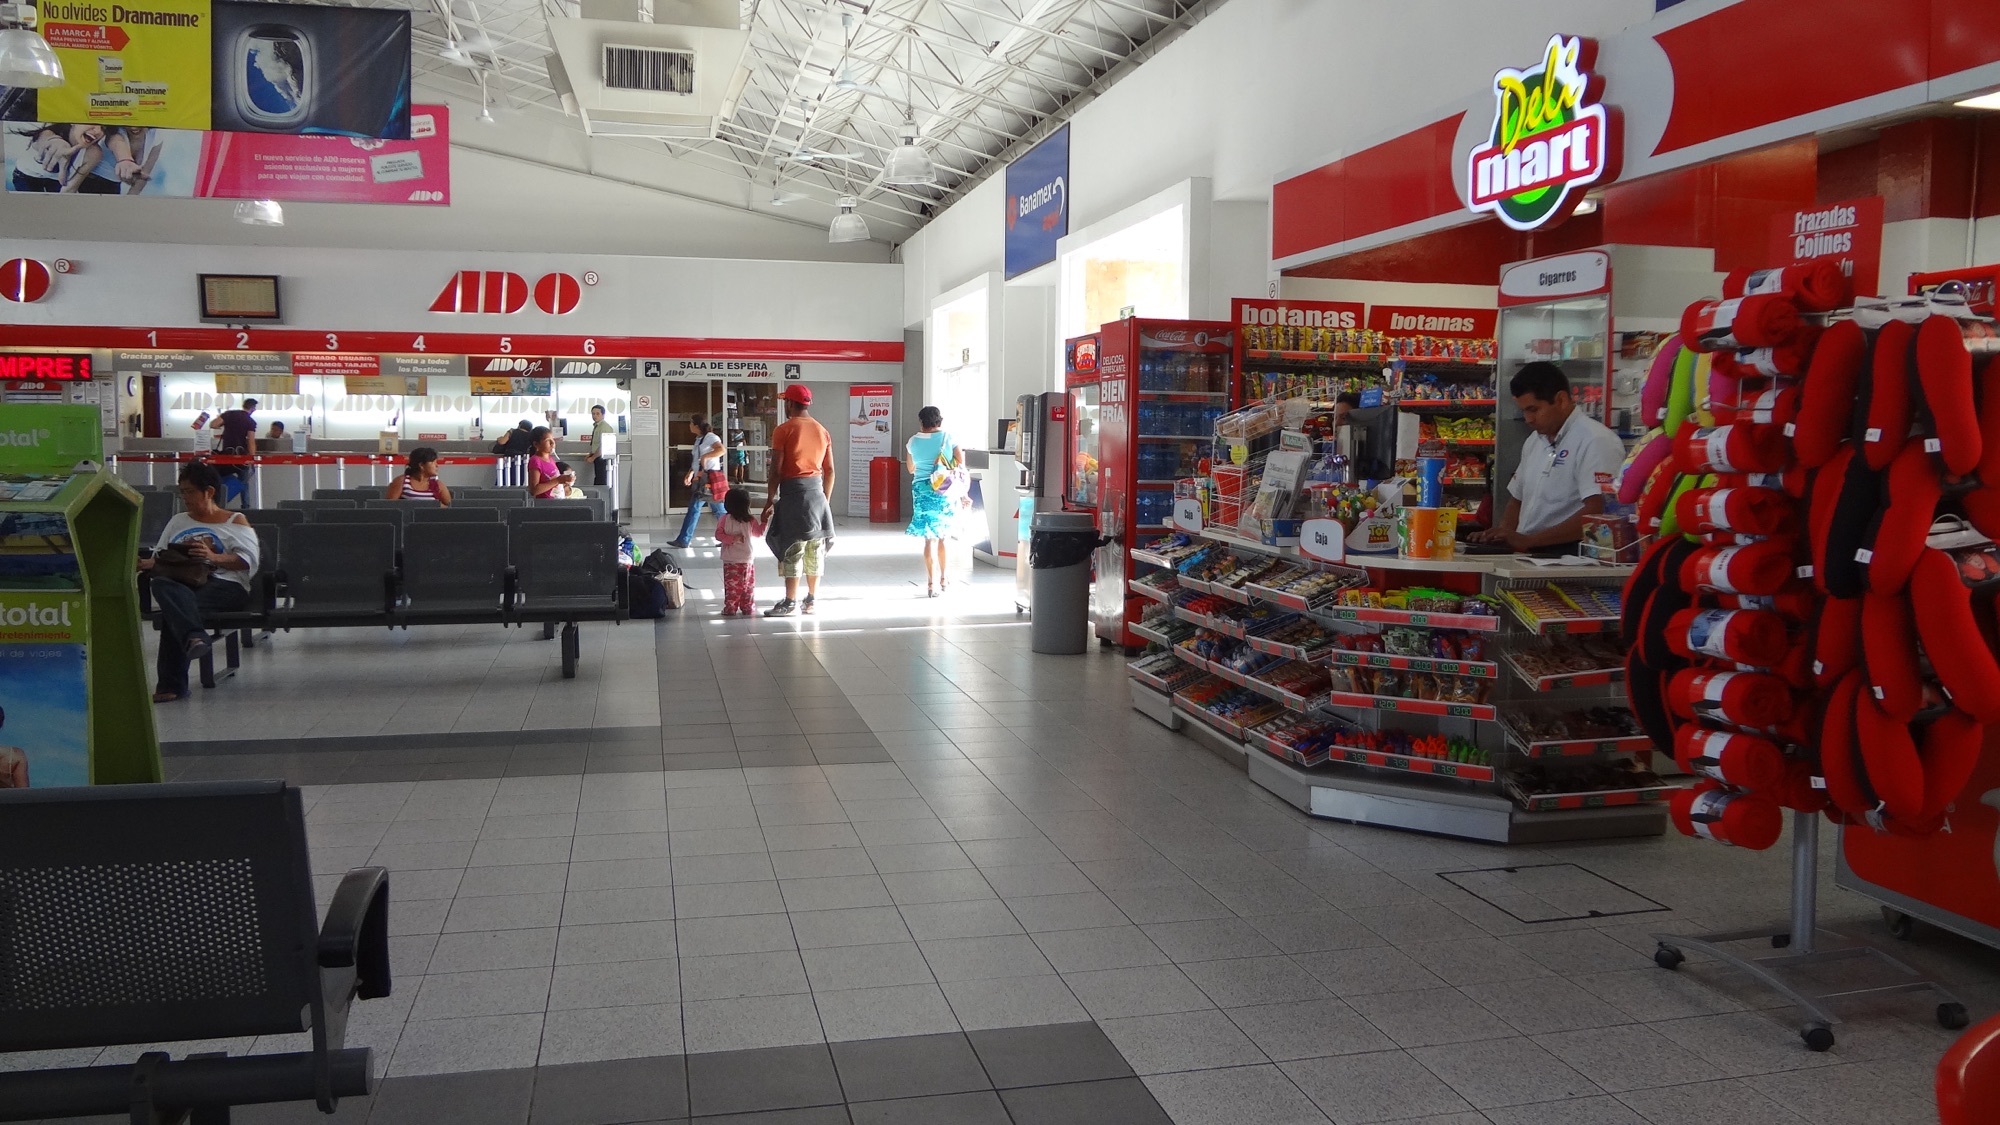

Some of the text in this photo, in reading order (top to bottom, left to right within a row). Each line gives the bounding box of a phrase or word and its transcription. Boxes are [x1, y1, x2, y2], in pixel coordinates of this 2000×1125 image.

[43, 1, 198, 27] No olvides Dramamine
[62, 29, 91, 38] MARCA
[93, 26, 106, 39] #1
[126, 86, 166, 95] Dramamine
[1498, 43, 1582, 158] Deli
[285, 154, 312, 162] servicio
[1477, 123, 1590, 199] mart
[275, 173, 288, 181] que
[408, 190, 444, 202] ADO
[1020, 182, 1052, 217] Banamex
[1794, 205, 1856, 233] Frazadas
[1794, 232, 1852, 259] Cojines
[1539, 269, 1577, 286] Cigarros
[428, 270, 582, 315] ADO
[1241, 304, 1356, 328] botanas
[1390, 313, 1475, 332] botanas
[147, 331, 157, 347] 1
[236, 332, 249, 349] 2
[326, 333, 339, 350] 3
[412, 335, 426, 351] 4
[500, 337, 512, 353] 5
[583, 339, 596, 355] 6
[154, 354, 169, 362] por
[170, 353, 194, 361] viajar
[484, 358, 527, 372] ADO
[680, 361, 768, 370] SALA DE ESPERA
[560, 362, 601, 374] ADO
[1101, 379, 1126, 402] BIEN
[1101, 403, 1125, 422] FRÍA
[1184, 509, 1193, 521] Caja
[1314, 532, 1328, 546] Caja
[1368, 525, 1391, 537] TOY
[0, 601, 71, 627] total
